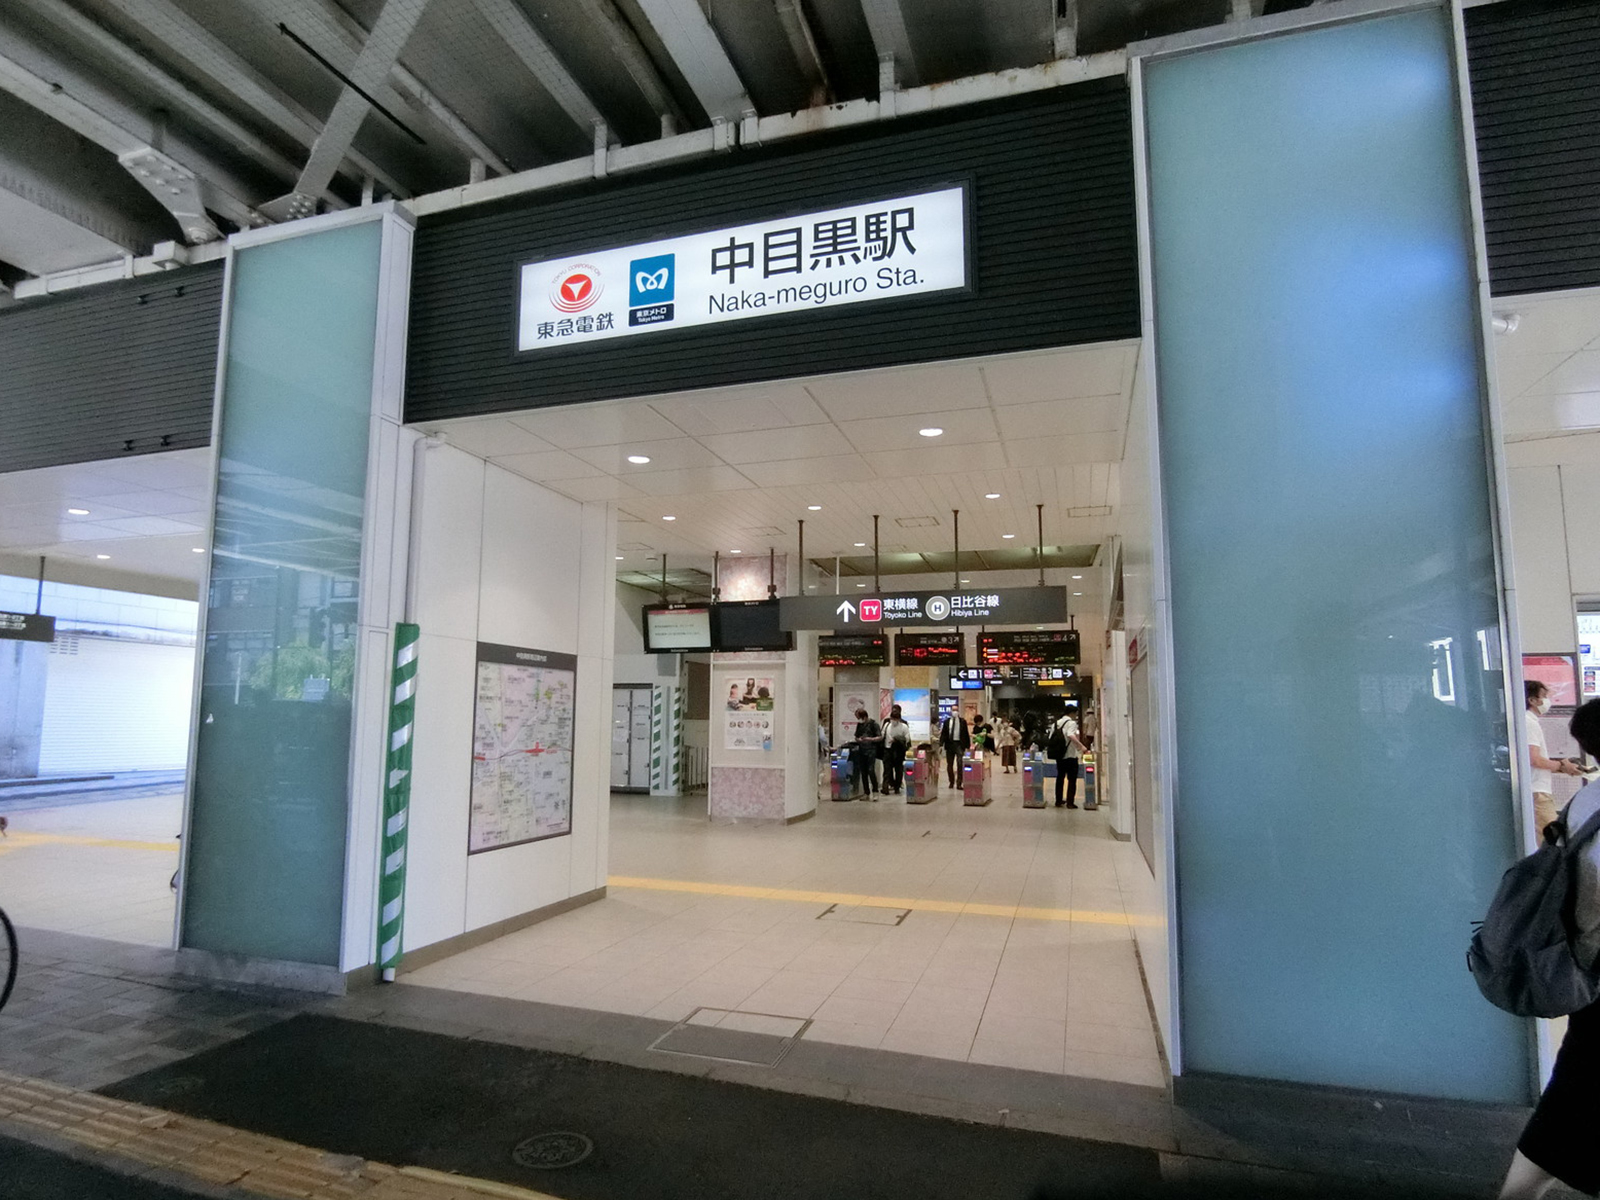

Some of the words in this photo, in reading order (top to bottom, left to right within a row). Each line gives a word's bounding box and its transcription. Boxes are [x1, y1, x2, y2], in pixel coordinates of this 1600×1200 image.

[711, 207, 916, 284] 中目黒駅
[708, 276, 867, 314] Naka-meguro
[876, 267, 925, 289] Sta.
[636, 307, 667, 318] 東京メトロ
[536, 312, 615, 340] 東急電鉄
[883, 598, 918, 611] 東横線
[951, 595, 1000, 608] 日比谷線
[863, 606, 878, 615] TY
[934, 604, 942, 612] H
[951, 608, 973, 617] Hibiya
[974, 608, 989, 616] Line
[883, 611, 907, 620] Toyoko
